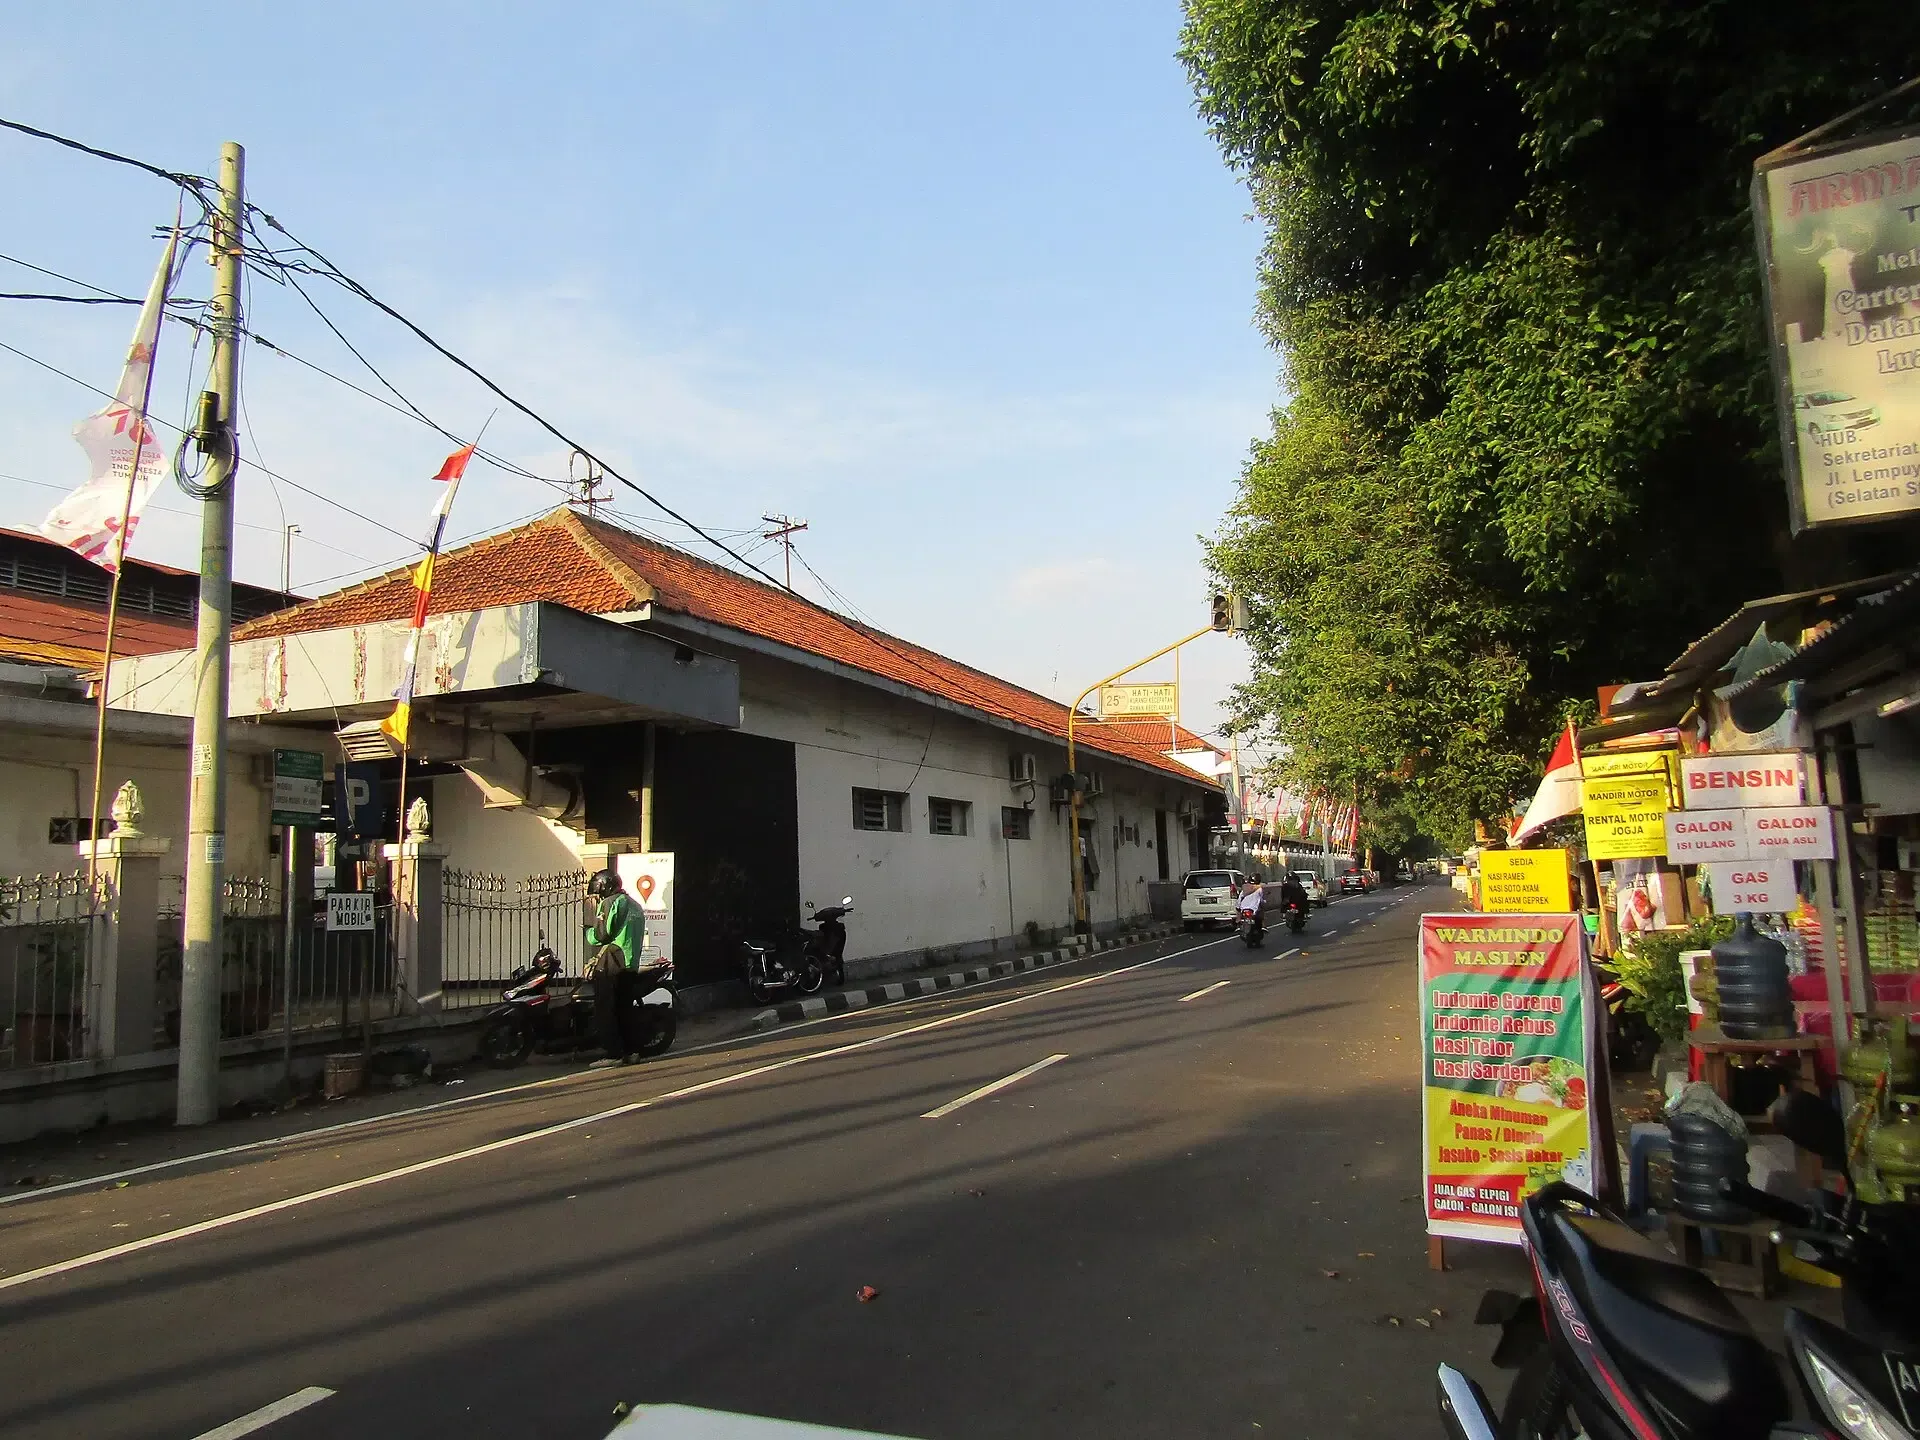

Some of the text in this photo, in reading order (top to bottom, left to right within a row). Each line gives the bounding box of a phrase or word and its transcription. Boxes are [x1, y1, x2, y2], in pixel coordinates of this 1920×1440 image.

[1877, 249, 1920, 273] Mel
[110, 449, 161, 460] INDOESIA
[1823, 441, 1919, 467] Sekretariat
[112, 471, 149, 482] TUMUH
[1828, 481, 1920, 508] (Selatan S
[1106, 695, 1120, 706] 25
[1689, 769, 1794, 790] BENSIN
[1588, 789, 1659, 801] MANDIRI MOTOR
[1588, 812, 1664, 825] RENTAL MOTOR
[1756, 817, 1818, 830] GALON
[1611, 825, 1644, 836] JOGJA
[1675, 820, 1733, 834] GALON
[1676, 839, 1736, 850] ISI ULANG
[1758, 836, 1818, 846] AQUA ASLI
[1509, 858, 1534, 866] SEDIA
[1487, 872, 1525, 881] NASI RAMES
[1731, 871, 1769, 885] GAS
[1488, 884, 1540, 893] NASI SOTO AYAM
[331, 897, 371, 911] PARKIR
[1489, 896, 1549, 905] NASI AYAM GEPREK
[1733, 893, 1769, 904] 3 KG
[336, 911, 366, 926] MOBIL
[1435, 928, 1564, 944] WARMINDO
[1454, 950, 1546, 967] MASLEN
[1432, 990, 1563, 1014] Indomie Goreng
[1433, 1014, 1556, 1036] Indomie Rebus
[1433, 1036, 1514, 1057] Nasi Telor
[1433, 1059, 1532, 1082] Nasi Sarden
[1450, 1099, 1549, 1126] Aneka Minuman
[1454, 1122, 1492, 1142] Panas
[1503, 1127, 1544, 1145] Dingin
[1439, 1146, 1480, 1163] Jasuke
[1488, 1147, 1523, 1163] Sosis
[1525, 1149, 1563, 1163] Bakar
[1433, 1184, 1510, 1202] JUAL GAS ELPIGI
[1433, 1198, 1464, 1212] GALON
[1471, 1202, 1503, 1216] GALON
[1504, 1205, 1518, 1217] ISI
